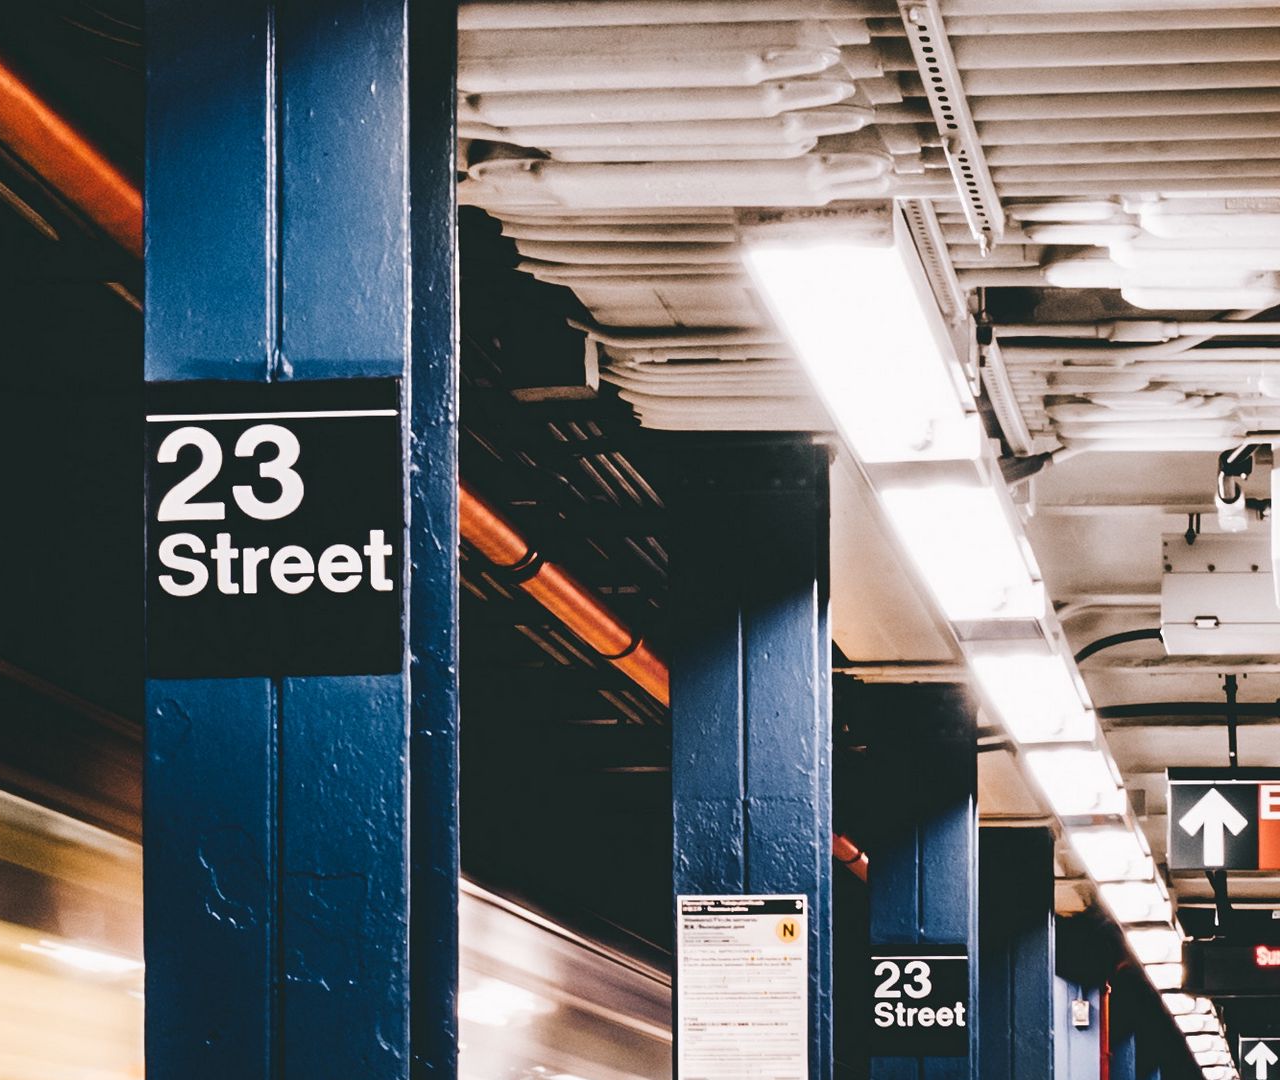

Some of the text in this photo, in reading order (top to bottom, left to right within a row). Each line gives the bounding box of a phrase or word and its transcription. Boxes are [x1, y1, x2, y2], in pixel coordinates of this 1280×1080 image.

[156, 423, 305, 522] 23
[157, 529, 394, 597] Street
[783, 923, 795, 938] N
[874, 960, 933, 999] 23
[874, 1001, 966, 1028] Street
